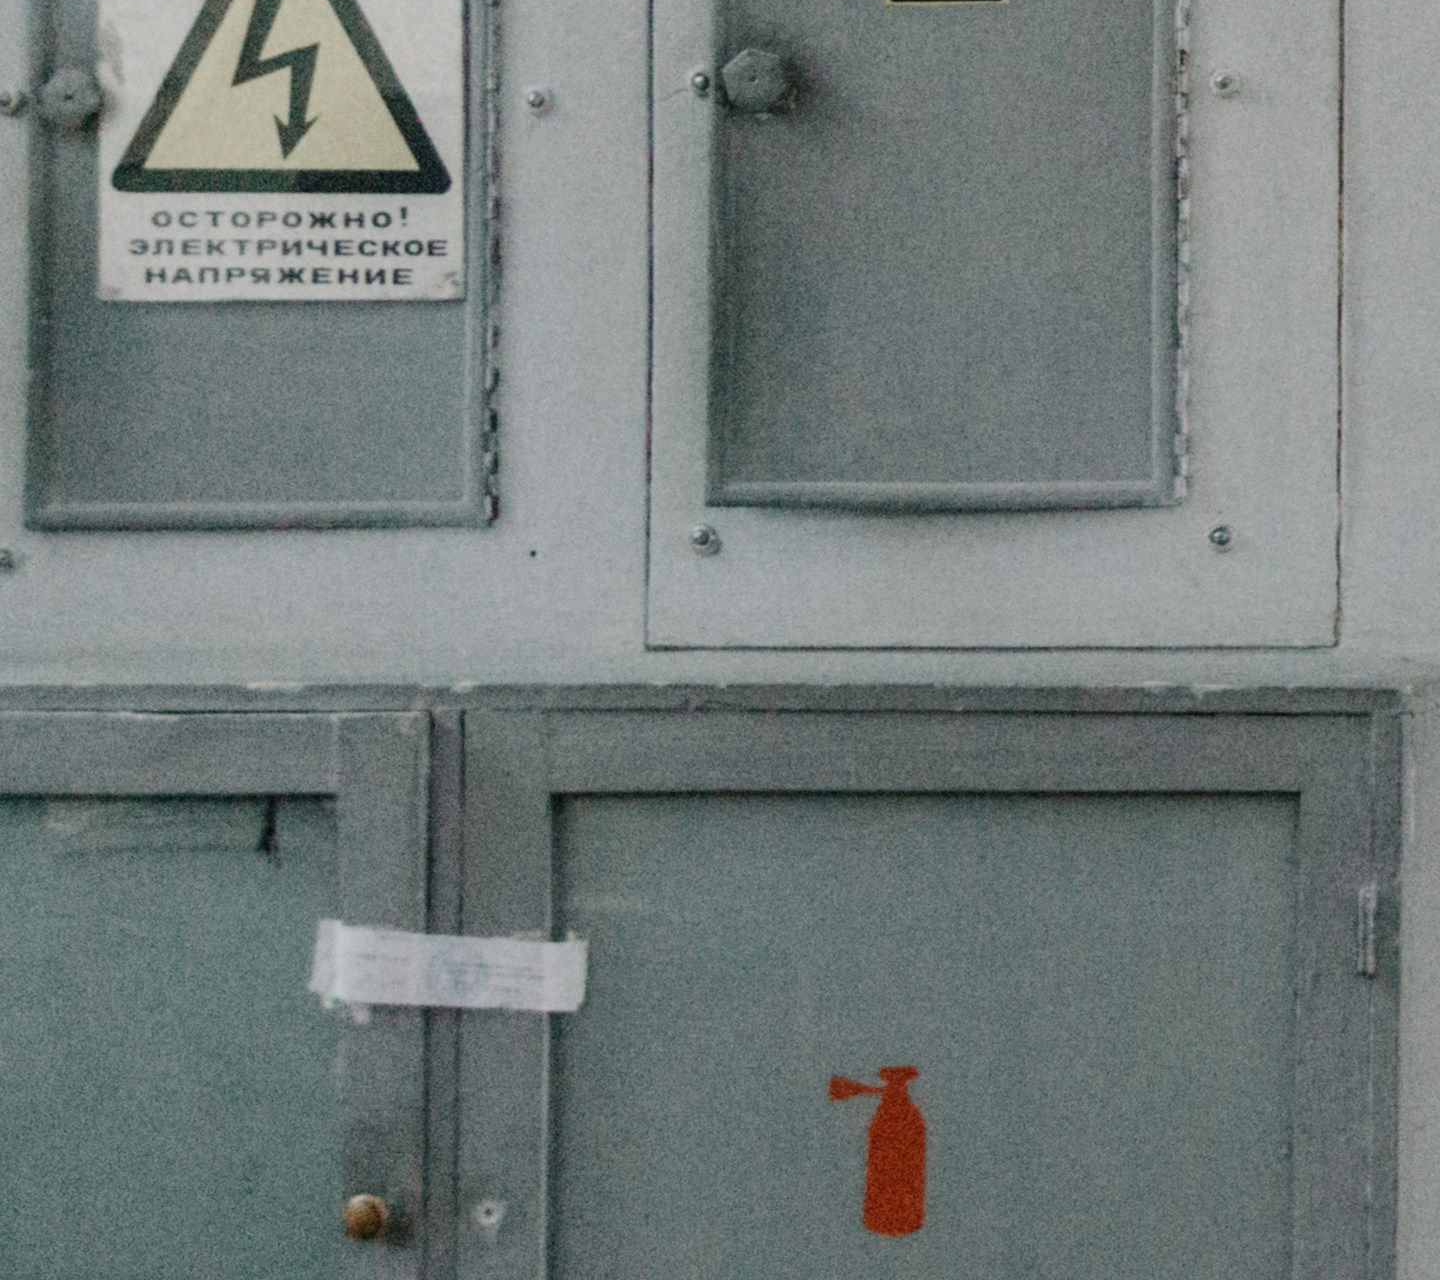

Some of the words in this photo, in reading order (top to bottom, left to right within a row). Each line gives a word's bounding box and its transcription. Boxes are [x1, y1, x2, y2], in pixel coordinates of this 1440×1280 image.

[151, 206, 409, 228] ОСТОРОЖНО!
[128, 239, 448, 257] ЭЛЕКТРИЧЕСКОЕ
[144, 266, 414, 285] НАПРЯЖЕНИЕ
